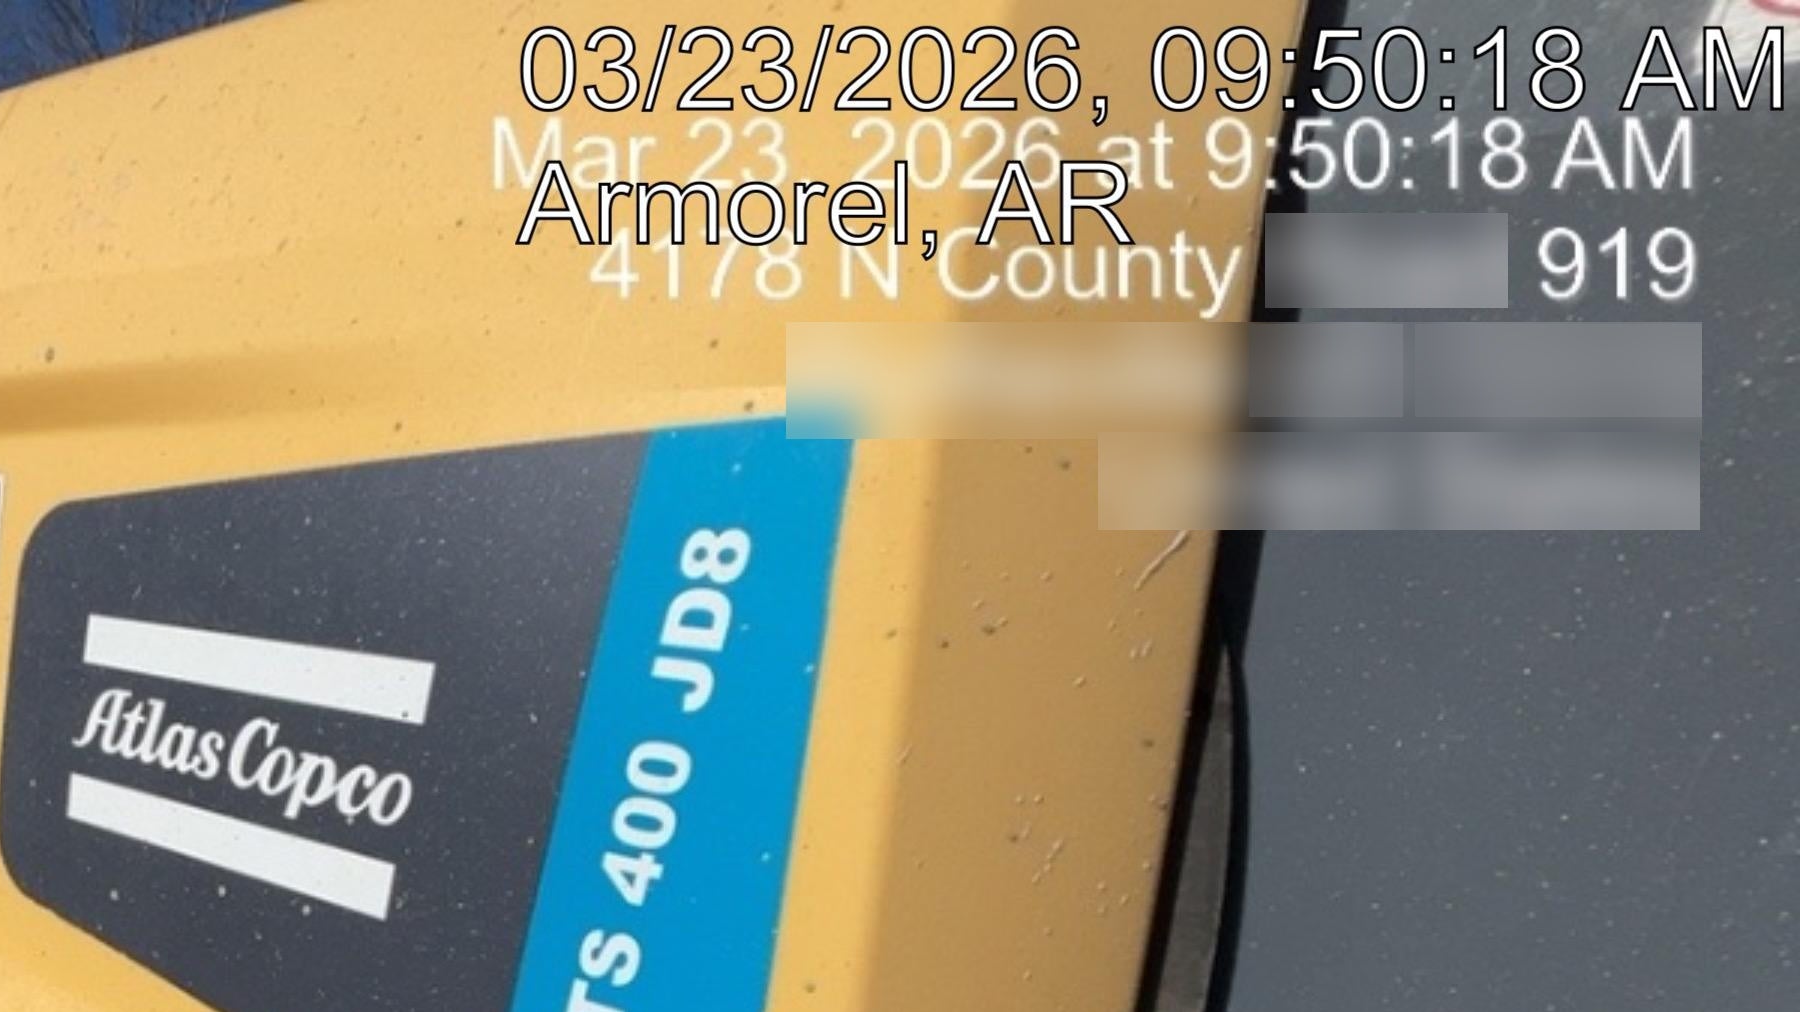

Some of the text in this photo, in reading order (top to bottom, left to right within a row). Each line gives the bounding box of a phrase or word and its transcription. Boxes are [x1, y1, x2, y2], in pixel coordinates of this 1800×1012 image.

[72, 688, 412, 827] Atlas Copco
[602, 741, 692, 906] 400
[651, 527, 752, 712] JD8
